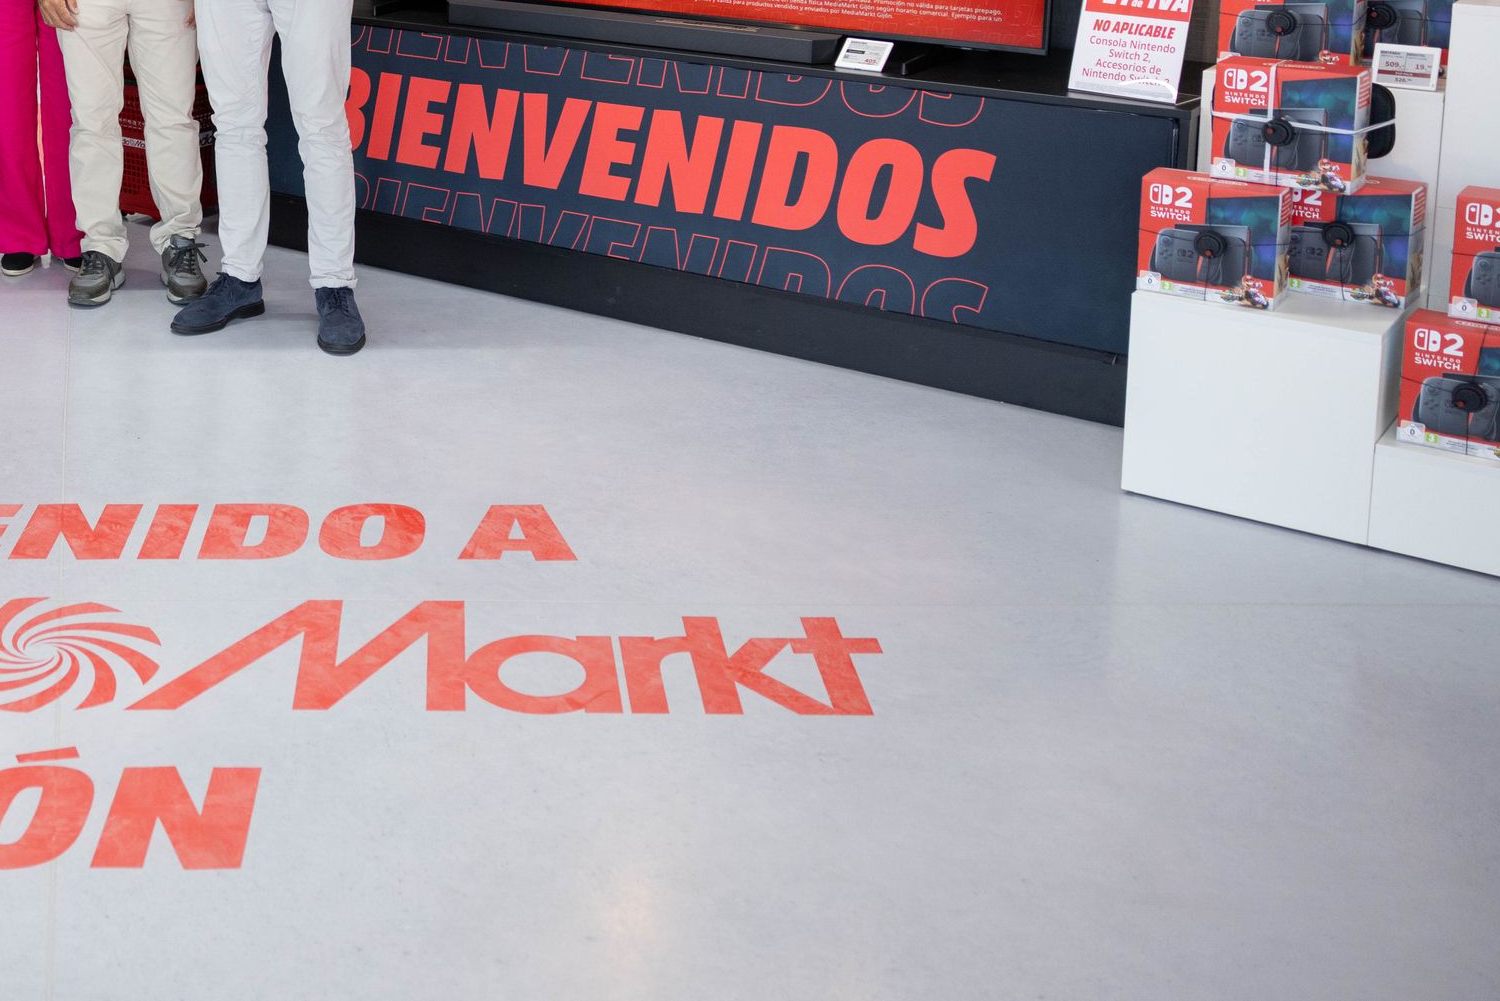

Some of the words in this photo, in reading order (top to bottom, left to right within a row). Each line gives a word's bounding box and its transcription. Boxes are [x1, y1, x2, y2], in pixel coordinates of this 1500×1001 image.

[1093, 19, 1111, 32] NO
[1111, 21, 1176, 40] APLICABLE
[1089, 35, 1127, 49] Consola
[1129, 40, 1176, 55] Nintendo
[1109, 48, 1140, 61] Switch
[1082, 67, 1127, 82] Nintendo
[1095, 58, 1147, 73] Accesorios
[1149, 64, 1162, 75] de
[1249, 70, 1268, 93] 2
[1224, 95, 1265, 106] SWITCH
[345, 65, 997, 259] BIENVENIDOS
[1174, 186, 1193, 209] 2
[1150, 211, 1190, 222] SWITCH
[1443, 333, 1464, 357] 2
[1414, 356, 1461, 371] SWITCH
[458, 503, 578, 561] A
[125, 599, 883, 716] Markt
